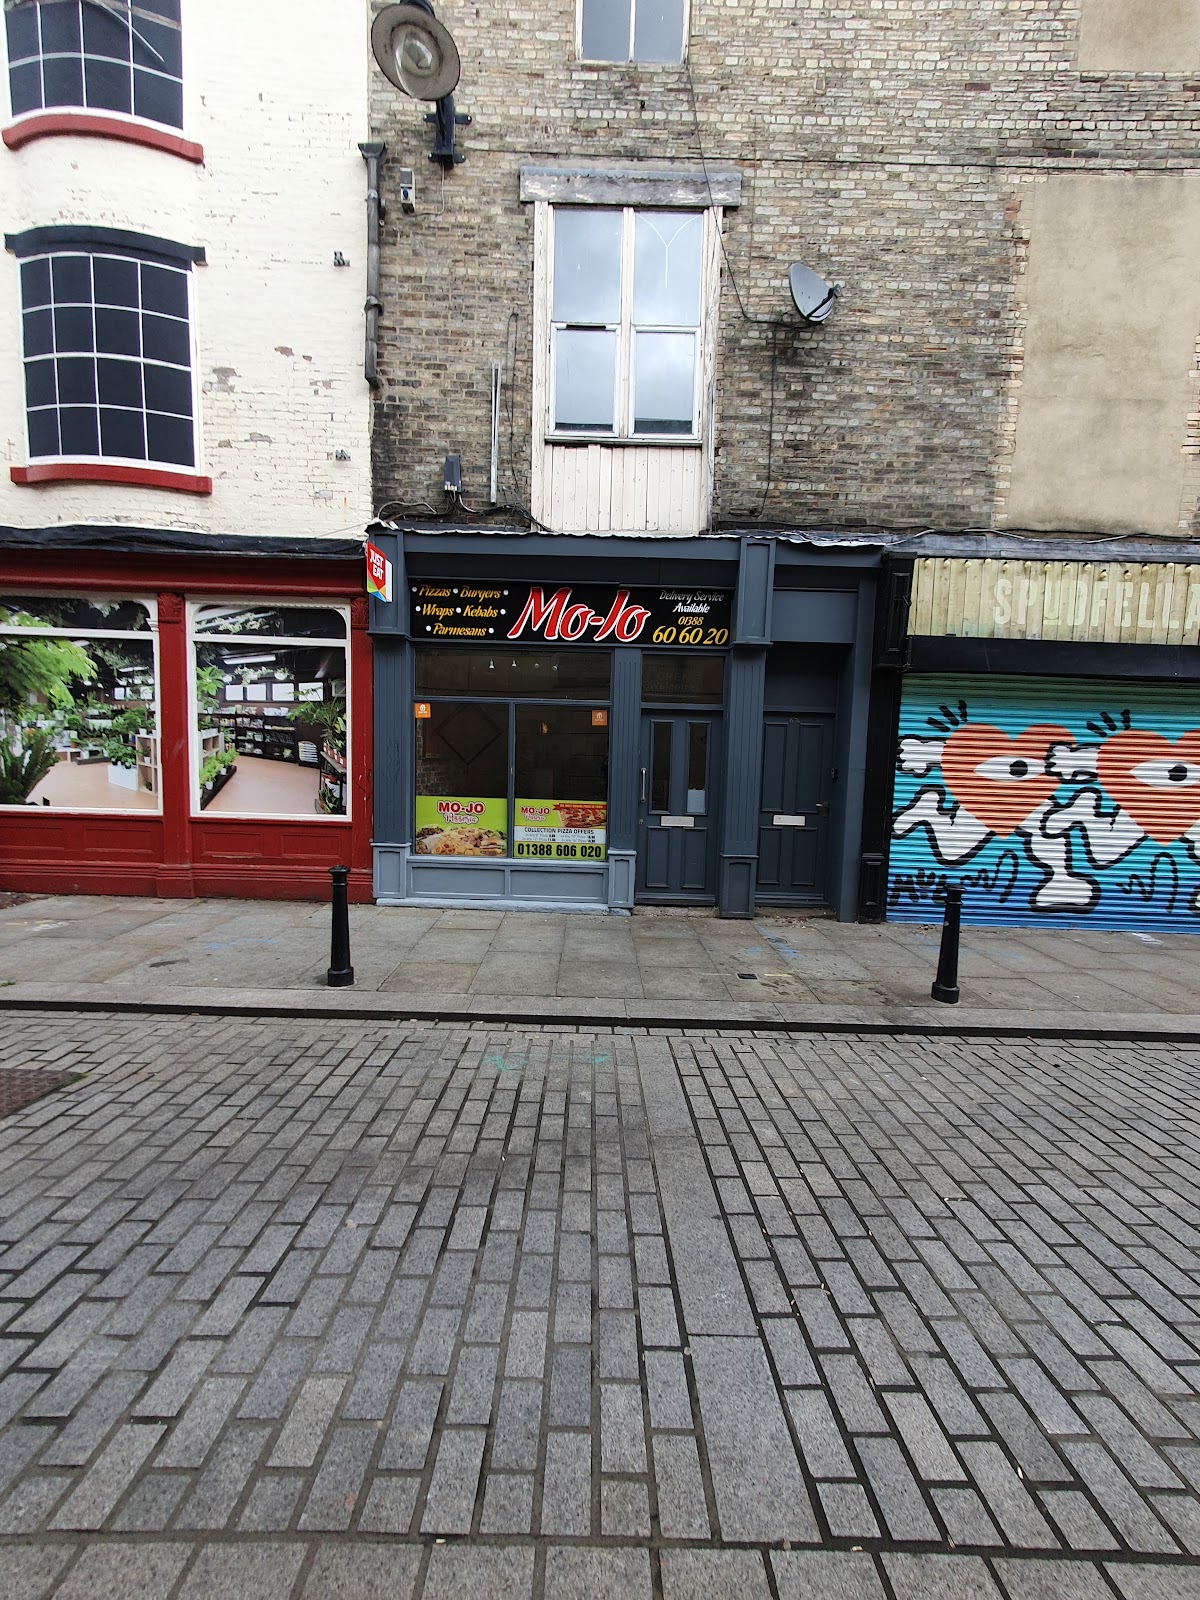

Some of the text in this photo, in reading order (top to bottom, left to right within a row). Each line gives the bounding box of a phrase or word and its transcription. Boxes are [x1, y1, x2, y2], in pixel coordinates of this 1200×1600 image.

[370, 549, 384, 568] JUST
[373, 564, 384, 580] EAT
[419, 584, 501, 603] Pizzas Burgers
[659, 590, 724, 604] Delivery Service
[422, 604, 498, 620] Wraps Kebabs
[507, 586, 651, 642] Mo-Jo
[672, 602, 710, 613] Available
[678, 616, 704, 626] 01388
[433, 623, 487, 636] Parmesans
[652, 626, 729, 645] 60 60 20
[438, 801, 485, 814] MO-JO
[521, 806, 550, 815] MO-JO
[518, 843, 602, 858] 01388 606 020
